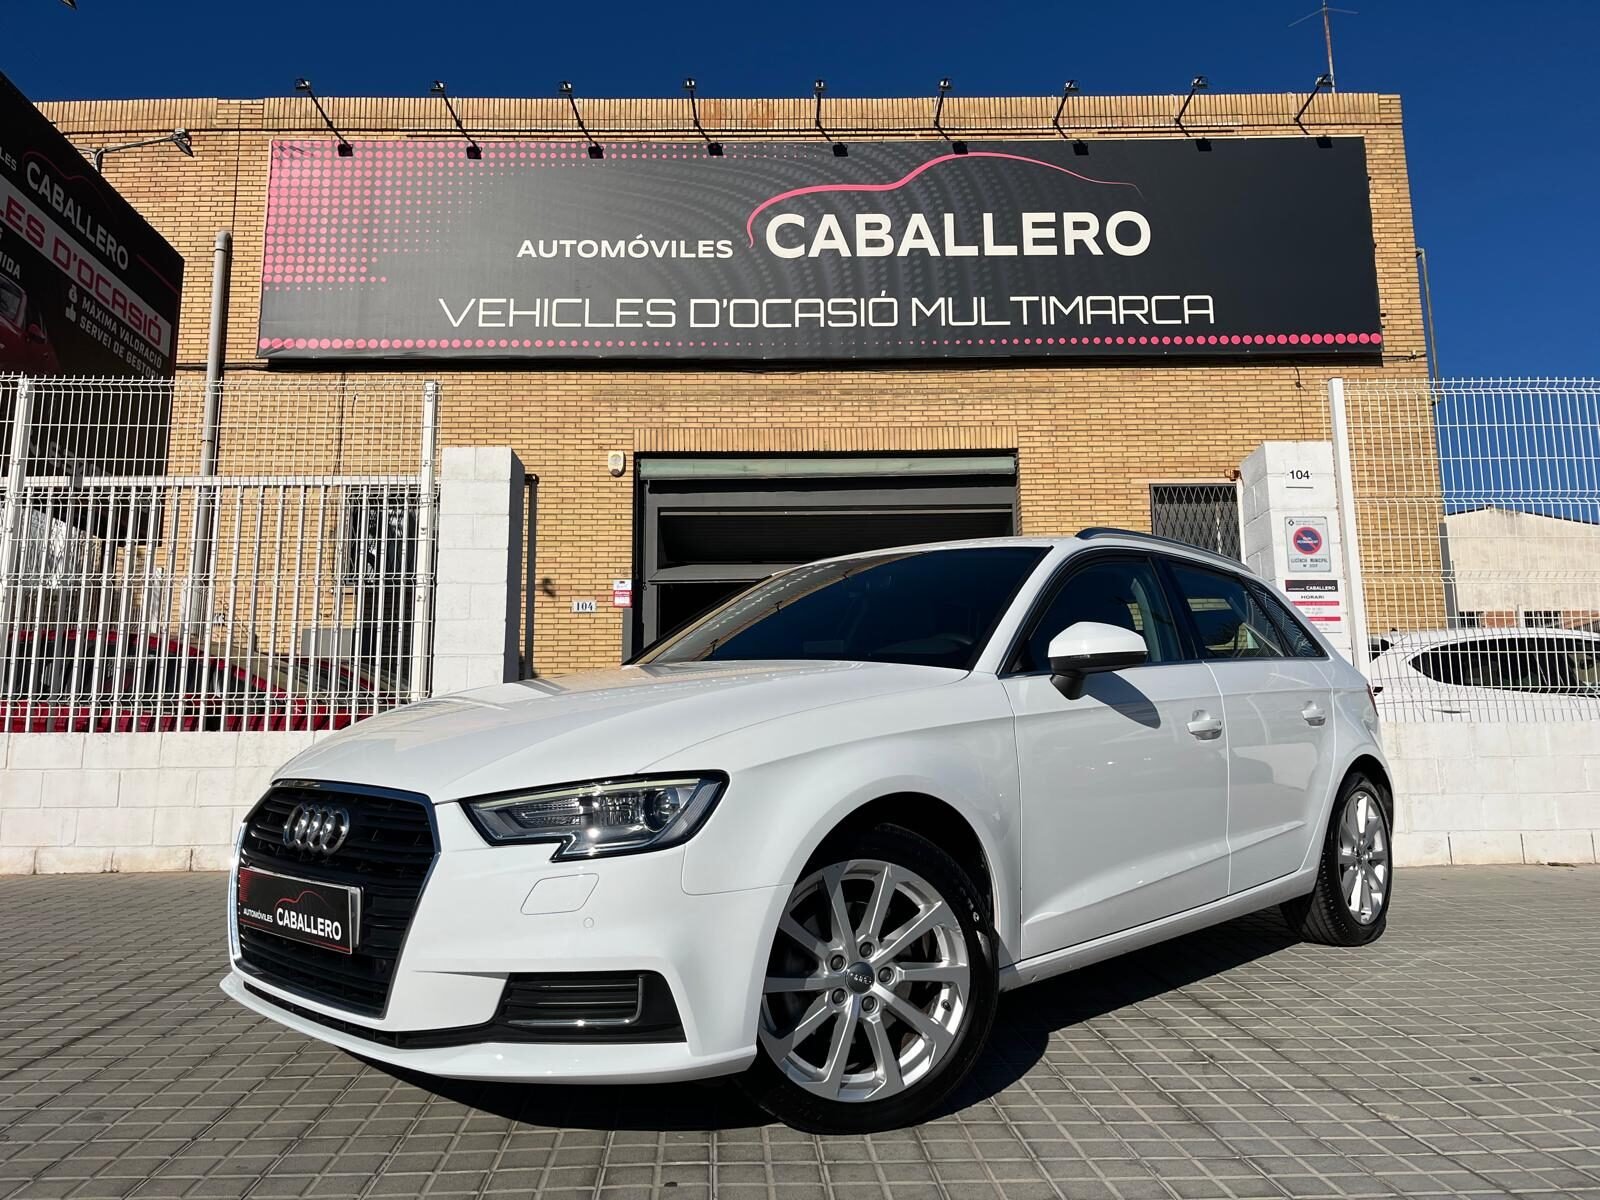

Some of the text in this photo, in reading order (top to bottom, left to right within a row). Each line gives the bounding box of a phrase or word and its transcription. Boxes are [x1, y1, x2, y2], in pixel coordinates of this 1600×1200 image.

[27, 161, 129, 270] CABALLERO
[517, 210, 1152, 259] AUTOMÓVILES CABALLERO
[0, 194, 162, 346] ES D'OCASIÓ
[438, 289, 1216, 330] VEHICLES D'OCASIÓ MULTIMARCA
[80, 315, 112, 348] SERVEI
[113, 340, 125, 358] DE
[120, 327, 163, 368] VALORACIÓ
[1289, 470, 1310, 480] 104
[576, 602, 593, 611] 104
[243, 907, 342, 941] AUTOMÓVILES CABALLERO
